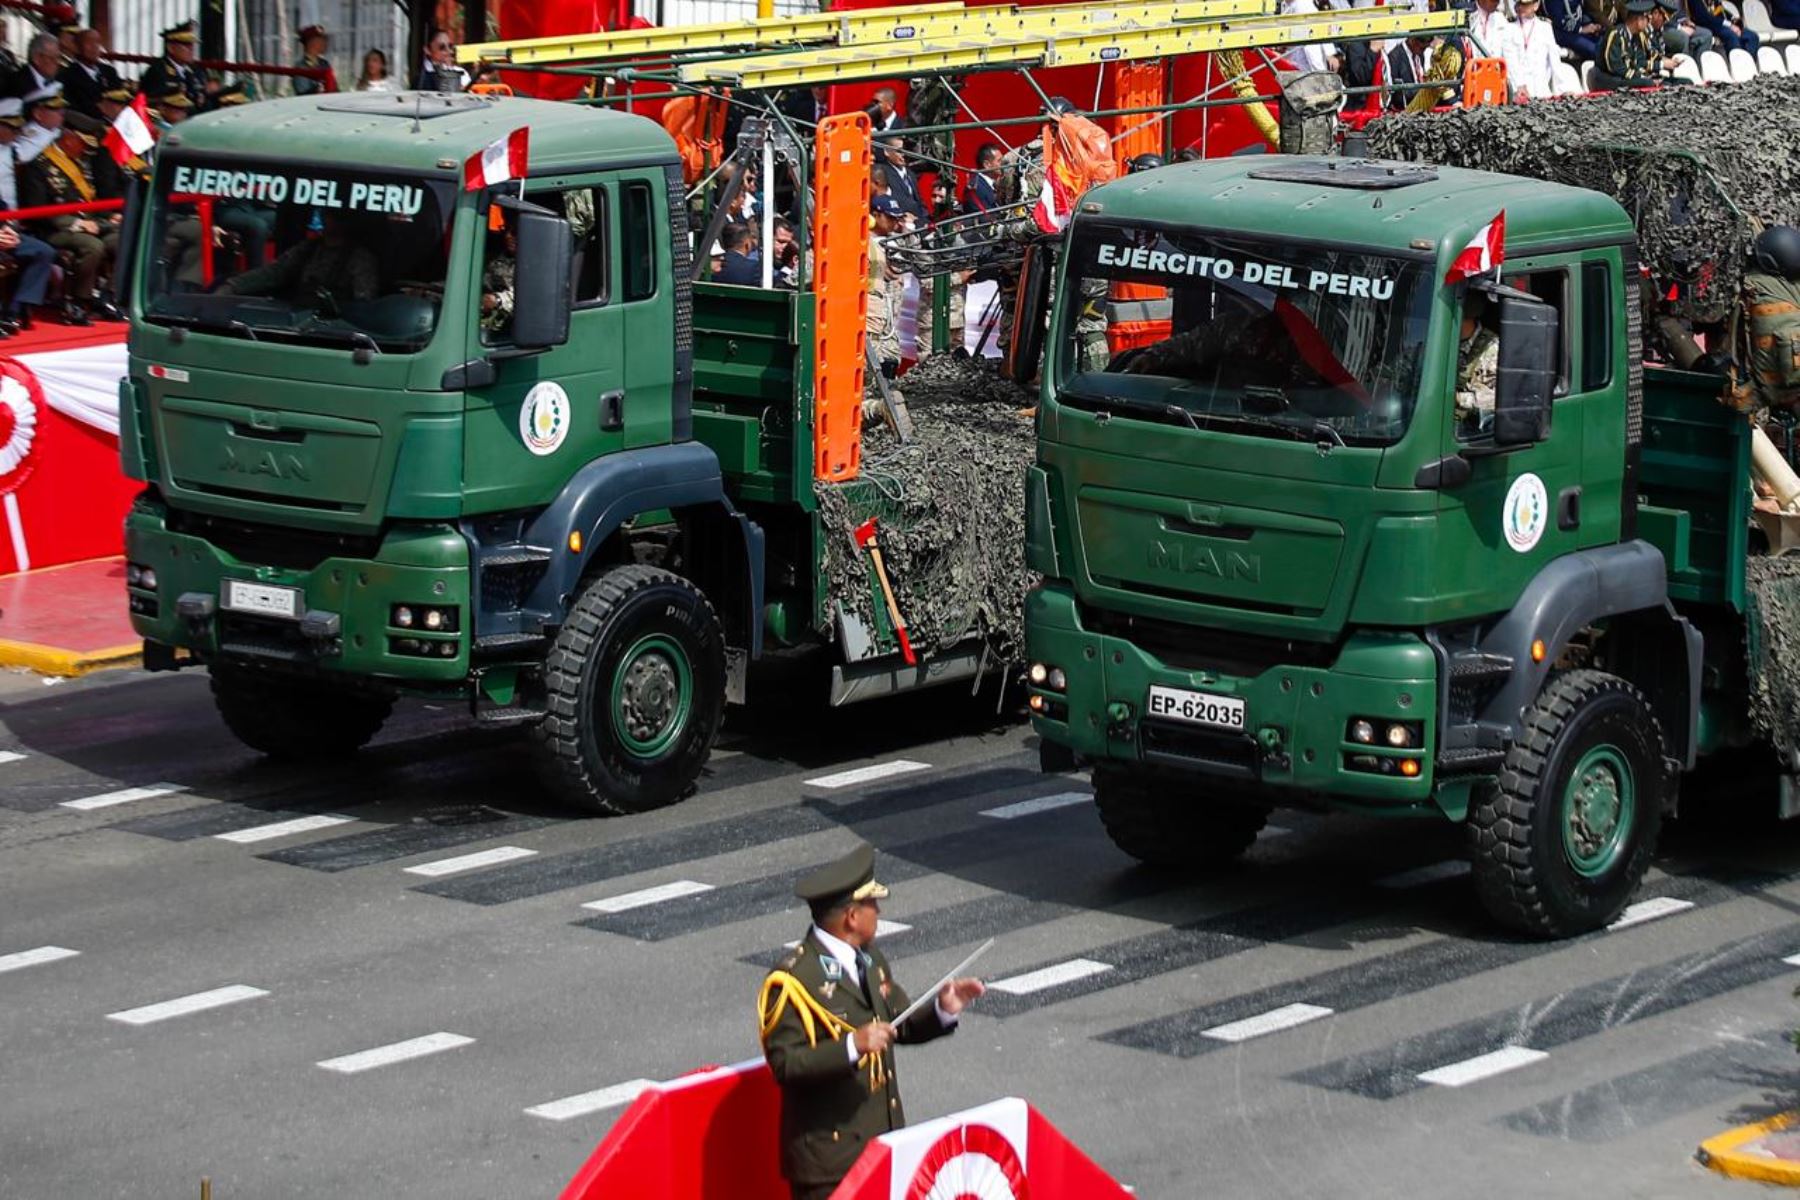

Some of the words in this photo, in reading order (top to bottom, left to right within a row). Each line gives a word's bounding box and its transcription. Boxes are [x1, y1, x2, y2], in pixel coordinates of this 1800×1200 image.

[173, 166, 288, 203] EJERCITO
[293, 177, 342, 208] DEL
[349, 182, 423, 216] PERU
[1097, 244, 1234, 280] EJÉRCITO
[1242, 262, 1299, 289] DEL
[1308, 270, 1395, 301] PERÚ
[218, 444, 312, 482] MAN
[1146, 540, 1261, 583] MAN
[1151, 694, 1243, 726] EP-62035
